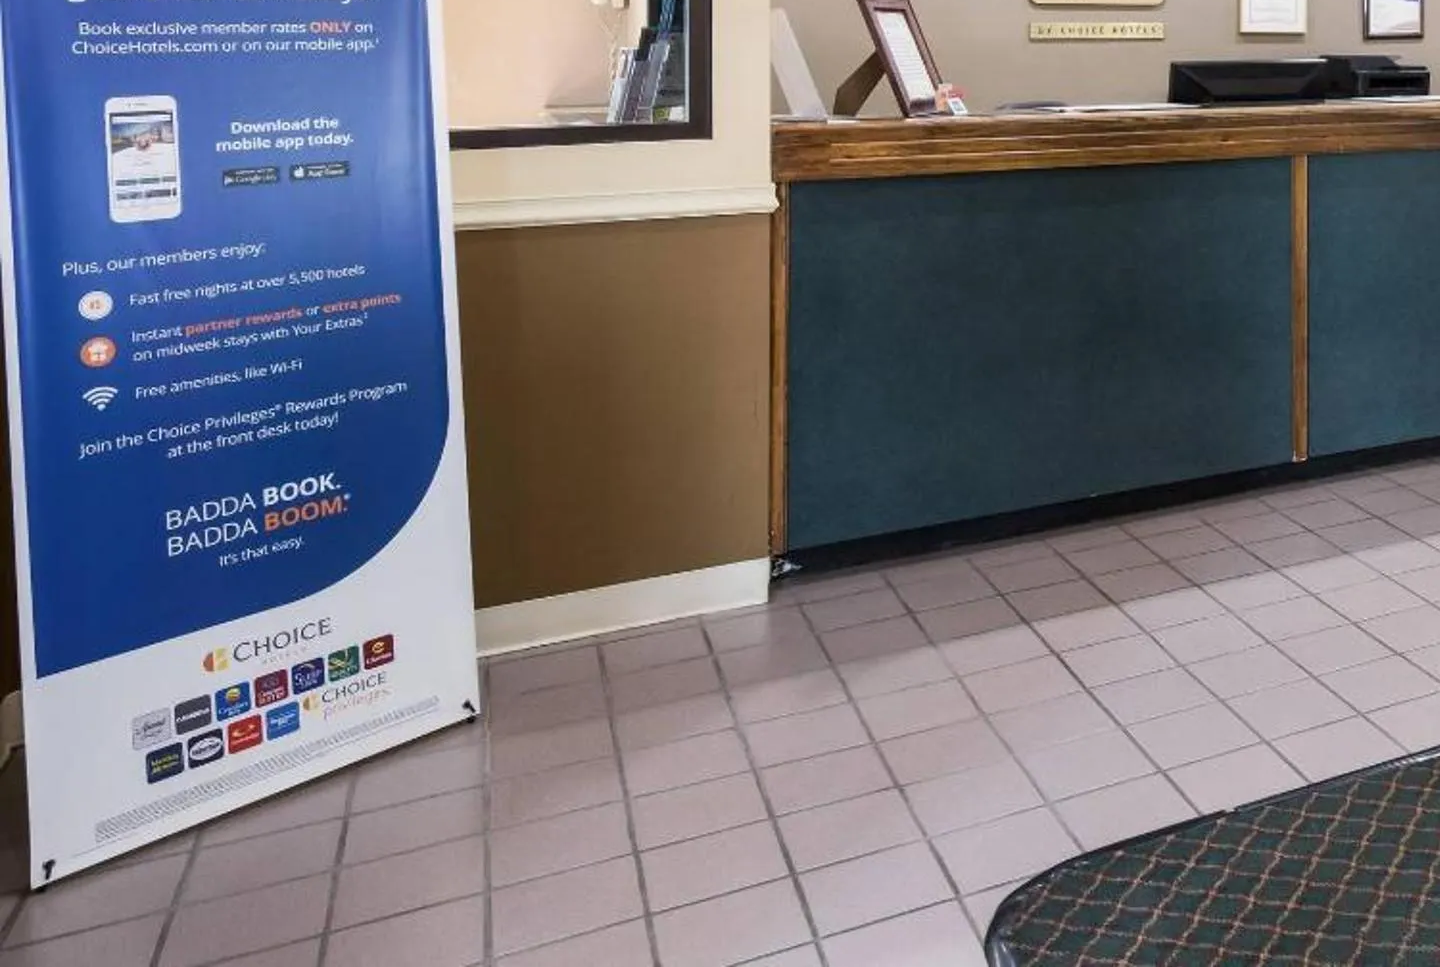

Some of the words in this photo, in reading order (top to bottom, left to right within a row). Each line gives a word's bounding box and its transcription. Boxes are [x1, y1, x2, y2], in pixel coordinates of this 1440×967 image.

[71, 40, 218, 54] ChoiceHotels.com
[222, 41, 238, 52] or
[242, 41, 262, 52] on
[265, 40, 291, 51] our
[295, 38, 343, 51] mobile
[78, 22, 122, 35] Book
[126, 21, 198, 35] exclusive
[201, 21, 266, 34] member
[270, 21, 307, 34] rates
[309, 21, 352, 34] ONLY
[354, 23, 373, 33] on
[216, 136, 273, 152] mobile
[275, 137, 304, 151] app
[307, 133, 354, 147] today.
[230, 117, 310, 134] Download
[313, 116, 339, 130] the
[62, 261, 103, 277] Plus,
[106, 257, 137, 272] our
[140, 247, 218, 267] members
[129, 293, 160, 307] Fast
[163, 288, 191, 302] free
[194, 282, 237, 298] nights
[241, 280, 254, 291] at
[256, 276, 286, 289] over
[289, 269, 324, 285] 5,500
[326, 264, 366, 280] hotels
[131, 326, 184, 343] Instant
[184, 317, 241, 338] partner
[245, 307, 303, 325] rewards
[306, 305, 320, 316] or
[322, 300, 359, 314] extra
[360, 292, 402, 311] points
[132, 350, 152, 362] on
[156, 337, 220, 359] midweek
[223, 333, 259, 348] stays
[261, 326, 290, 341] with
[292, 322, 322, 336] Your
[135, 384, 167, 400] Free
[170, 371, 242, 393] amenities,
[245, 366, 268, 379] like
[270, 358, 303, 375] Wi-Fi
[79, 439, 112, 460] Join
[116, 433, 144, 450] the
[147, 422, 201, 443] Choice
[285, 392, 347, 415] Rewards
[349, 382, 408, 401] Program
[168, 445, 184, 459] at
[187, 438, 213, 454] the
[216, 430, 254, 448] front
[256, 421, 292, 440] desk
[295, 411, 339, 432] today!
[166, 492, 257, 531] BADDA
[262, 472, 342, 507] BOOK.
[168, 518, 258, 557] BADDA
[219, 552, 239, 567] It's
[241, 543, 269, 561] that
[233, 617, 333, 663] CHOICE
[322, 671, 388, 704] CHOICE
